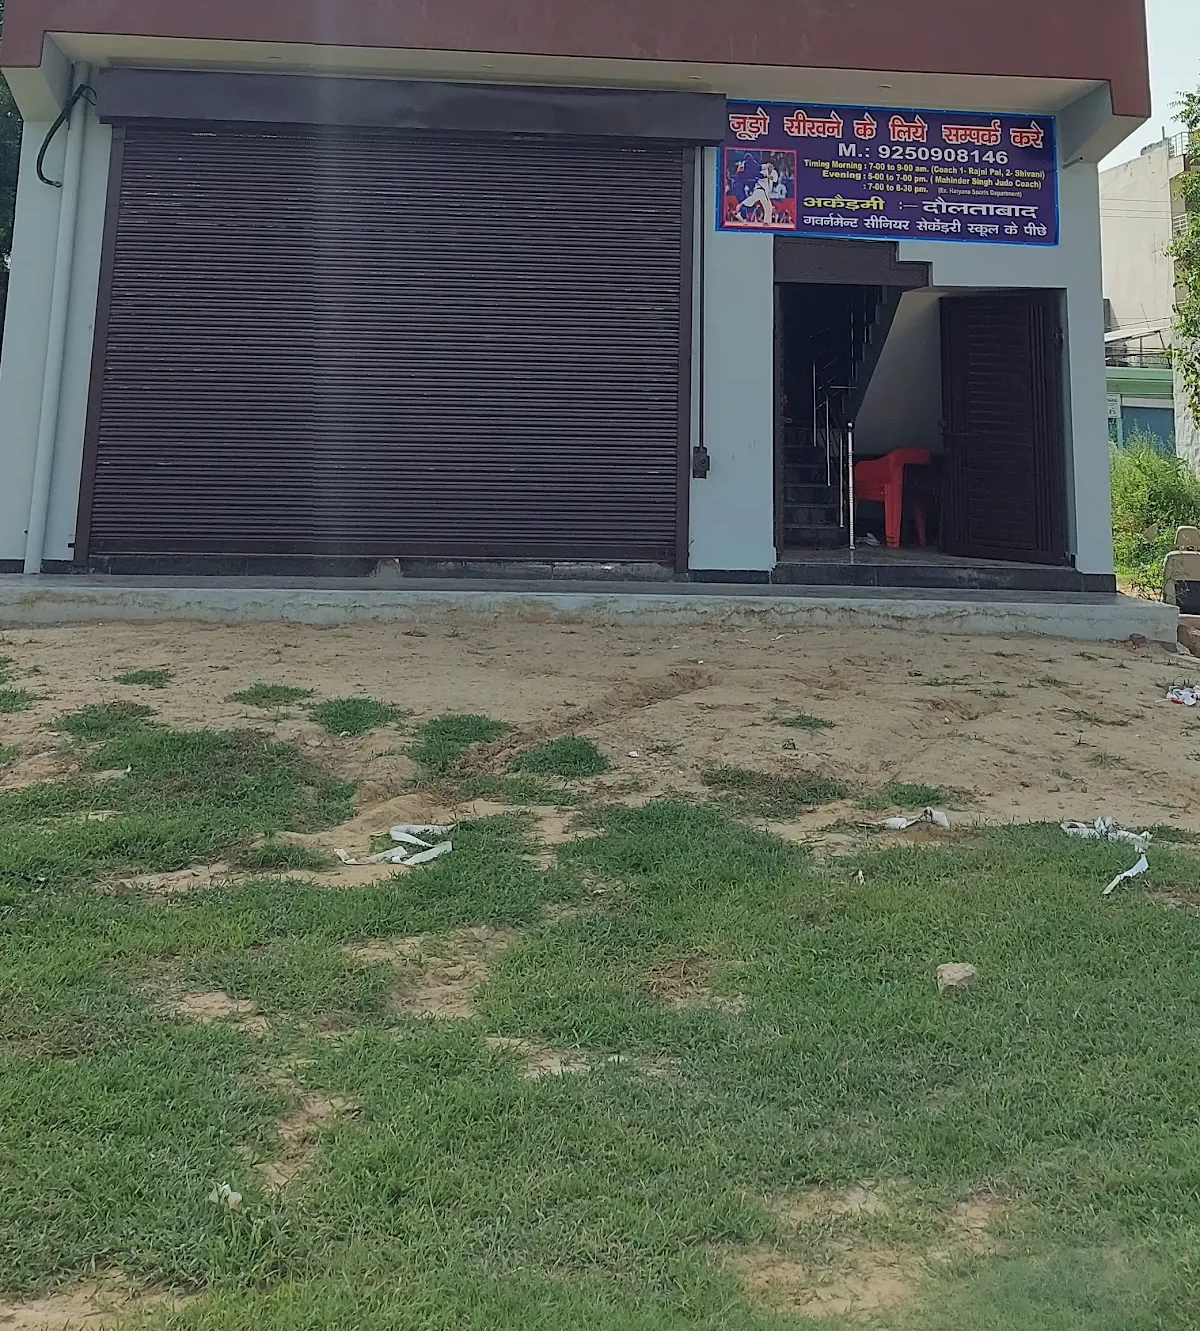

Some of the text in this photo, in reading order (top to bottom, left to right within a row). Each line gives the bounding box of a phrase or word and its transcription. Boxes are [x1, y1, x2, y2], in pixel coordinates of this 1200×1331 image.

[783, 109, 843, 139] सीखने
[853, 111, 877, 140] के
[889, 114, 928, 143] लिये
[941, 119, 1001, 146] सम्पर्क
[1009, 120, 1044, 149] करे
[878, 145, 1009, 164] 9250908146
[803, 159, 830, 169] Timing
[831, 160, 862, 171] Morning
[868, 162, 885, 171] 7-00
[896, 164, 913, 172] 9-00
[931, 165, 957, 174] (Coach
[968, 168, 987, 177] Rajni
[989, 168, 1004, 177] Pal,
[1014, 170, 1045, 180] Shivani)
[822, 170, 862, 180] Evening
[896, 174, 913, 182] 7-00
[914, 176, 929, 184] pm.
[935, 175, 970, 185] Mahinder
[971, 177, 993, 187] Singh
[995, 178, 1013, 187] Judo
[1015, 180, 1042, 190] Coach)
[867, 183, 884, 191] 7-00
[886, 184, 894, 192] to
[914, 186, 929, 195] pm.
[922, 196, 1039, 219] दौलताबाद
[863, 215, 910, 230] सीनियर
[967, 223, 1000, 238] स्कूल
[1004, 221, 1018, 236] के
[1023, 222, 1048, 237] पीछे
